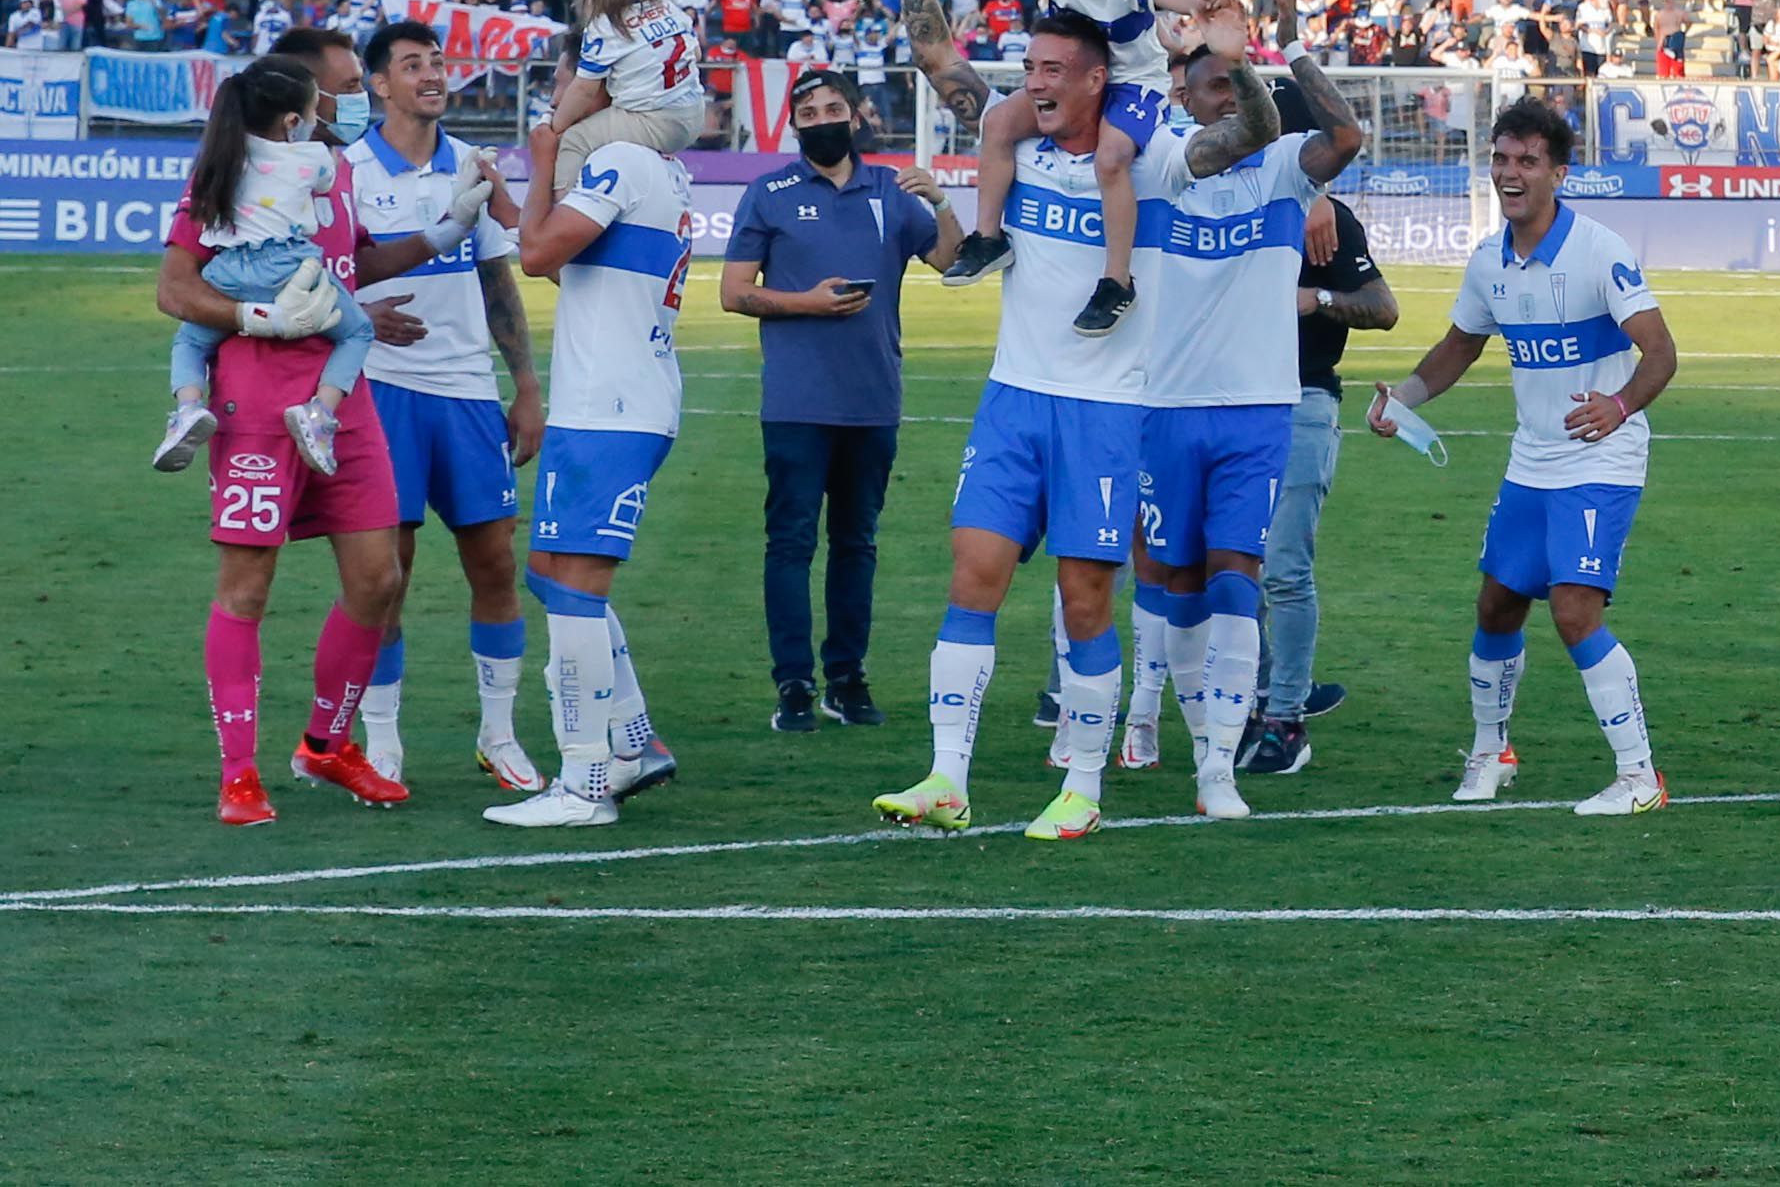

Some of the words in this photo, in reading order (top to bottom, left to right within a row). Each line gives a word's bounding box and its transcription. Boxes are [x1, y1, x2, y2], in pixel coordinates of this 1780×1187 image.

[640, 16, 679, 43] LOLA
[0, 83, 68, 113] CTAVA
[1565, 179, 1618, 194] CRISTAL
[1197, 217, 1265, 251] BICE
[1515, 336, 1581, 363] BICE
[219, 484, 281, 533] 25
